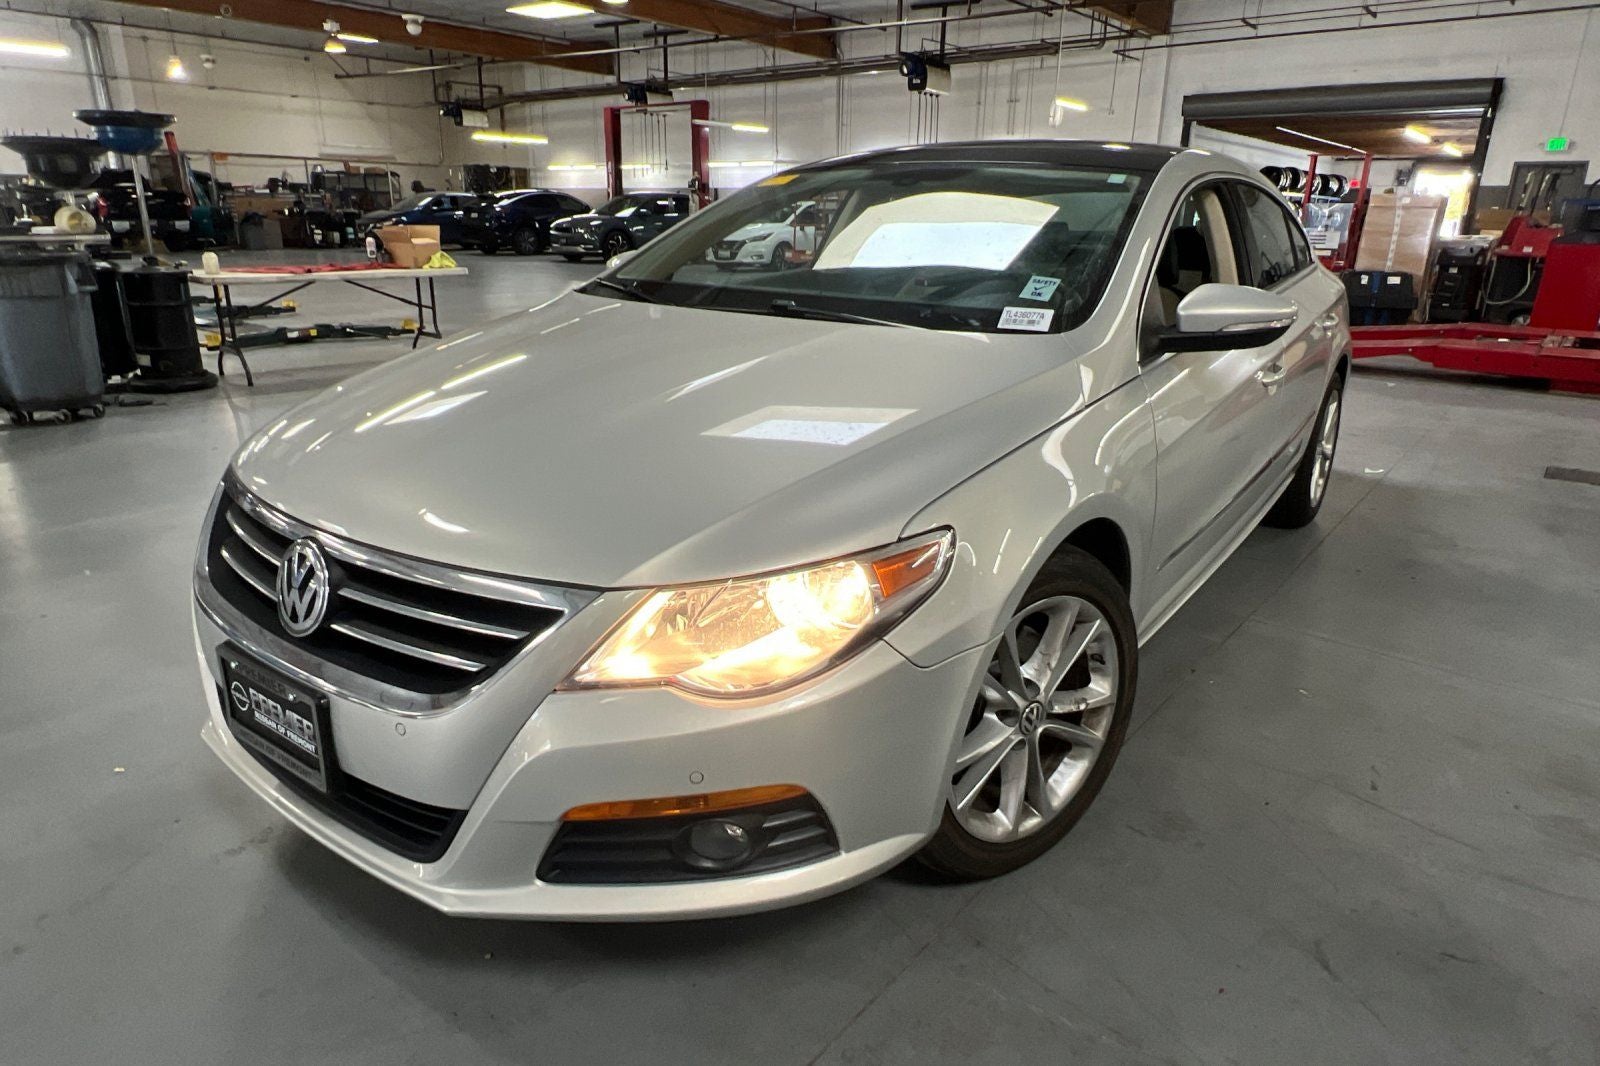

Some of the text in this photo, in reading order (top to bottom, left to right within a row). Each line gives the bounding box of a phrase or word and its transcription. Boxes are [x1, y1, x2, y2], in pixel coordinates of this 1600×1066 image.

[1032, 278, 1057, 287] SAFETY
[248, 686, 314, 743] PREMIER
[277, 723, 286, 735] OF
